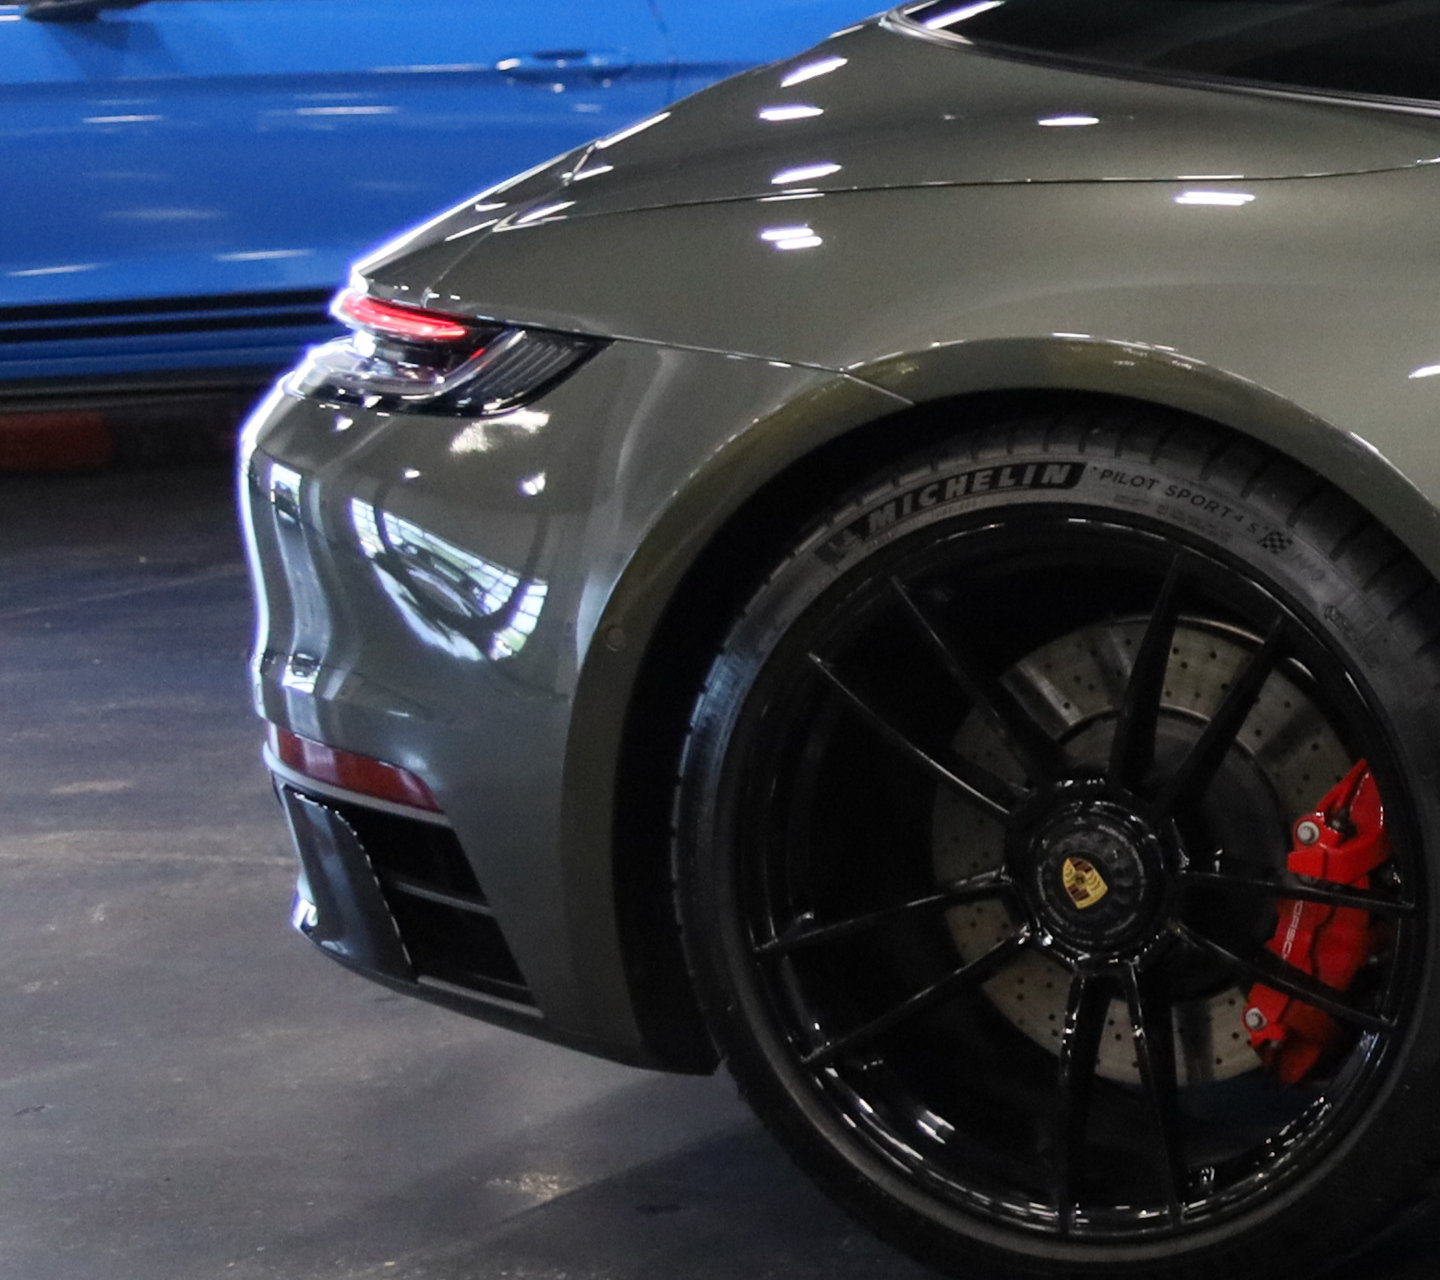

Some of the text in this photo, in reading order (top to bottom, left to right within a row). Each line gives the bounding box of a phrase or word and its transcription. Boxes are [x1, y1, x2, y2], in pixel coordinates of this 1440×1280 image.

[868, 463, 1072, 533] MICHELIN
[1100, 468, 1160, 491] PILOT
[1164, 485, 1234, 518] SPORT
